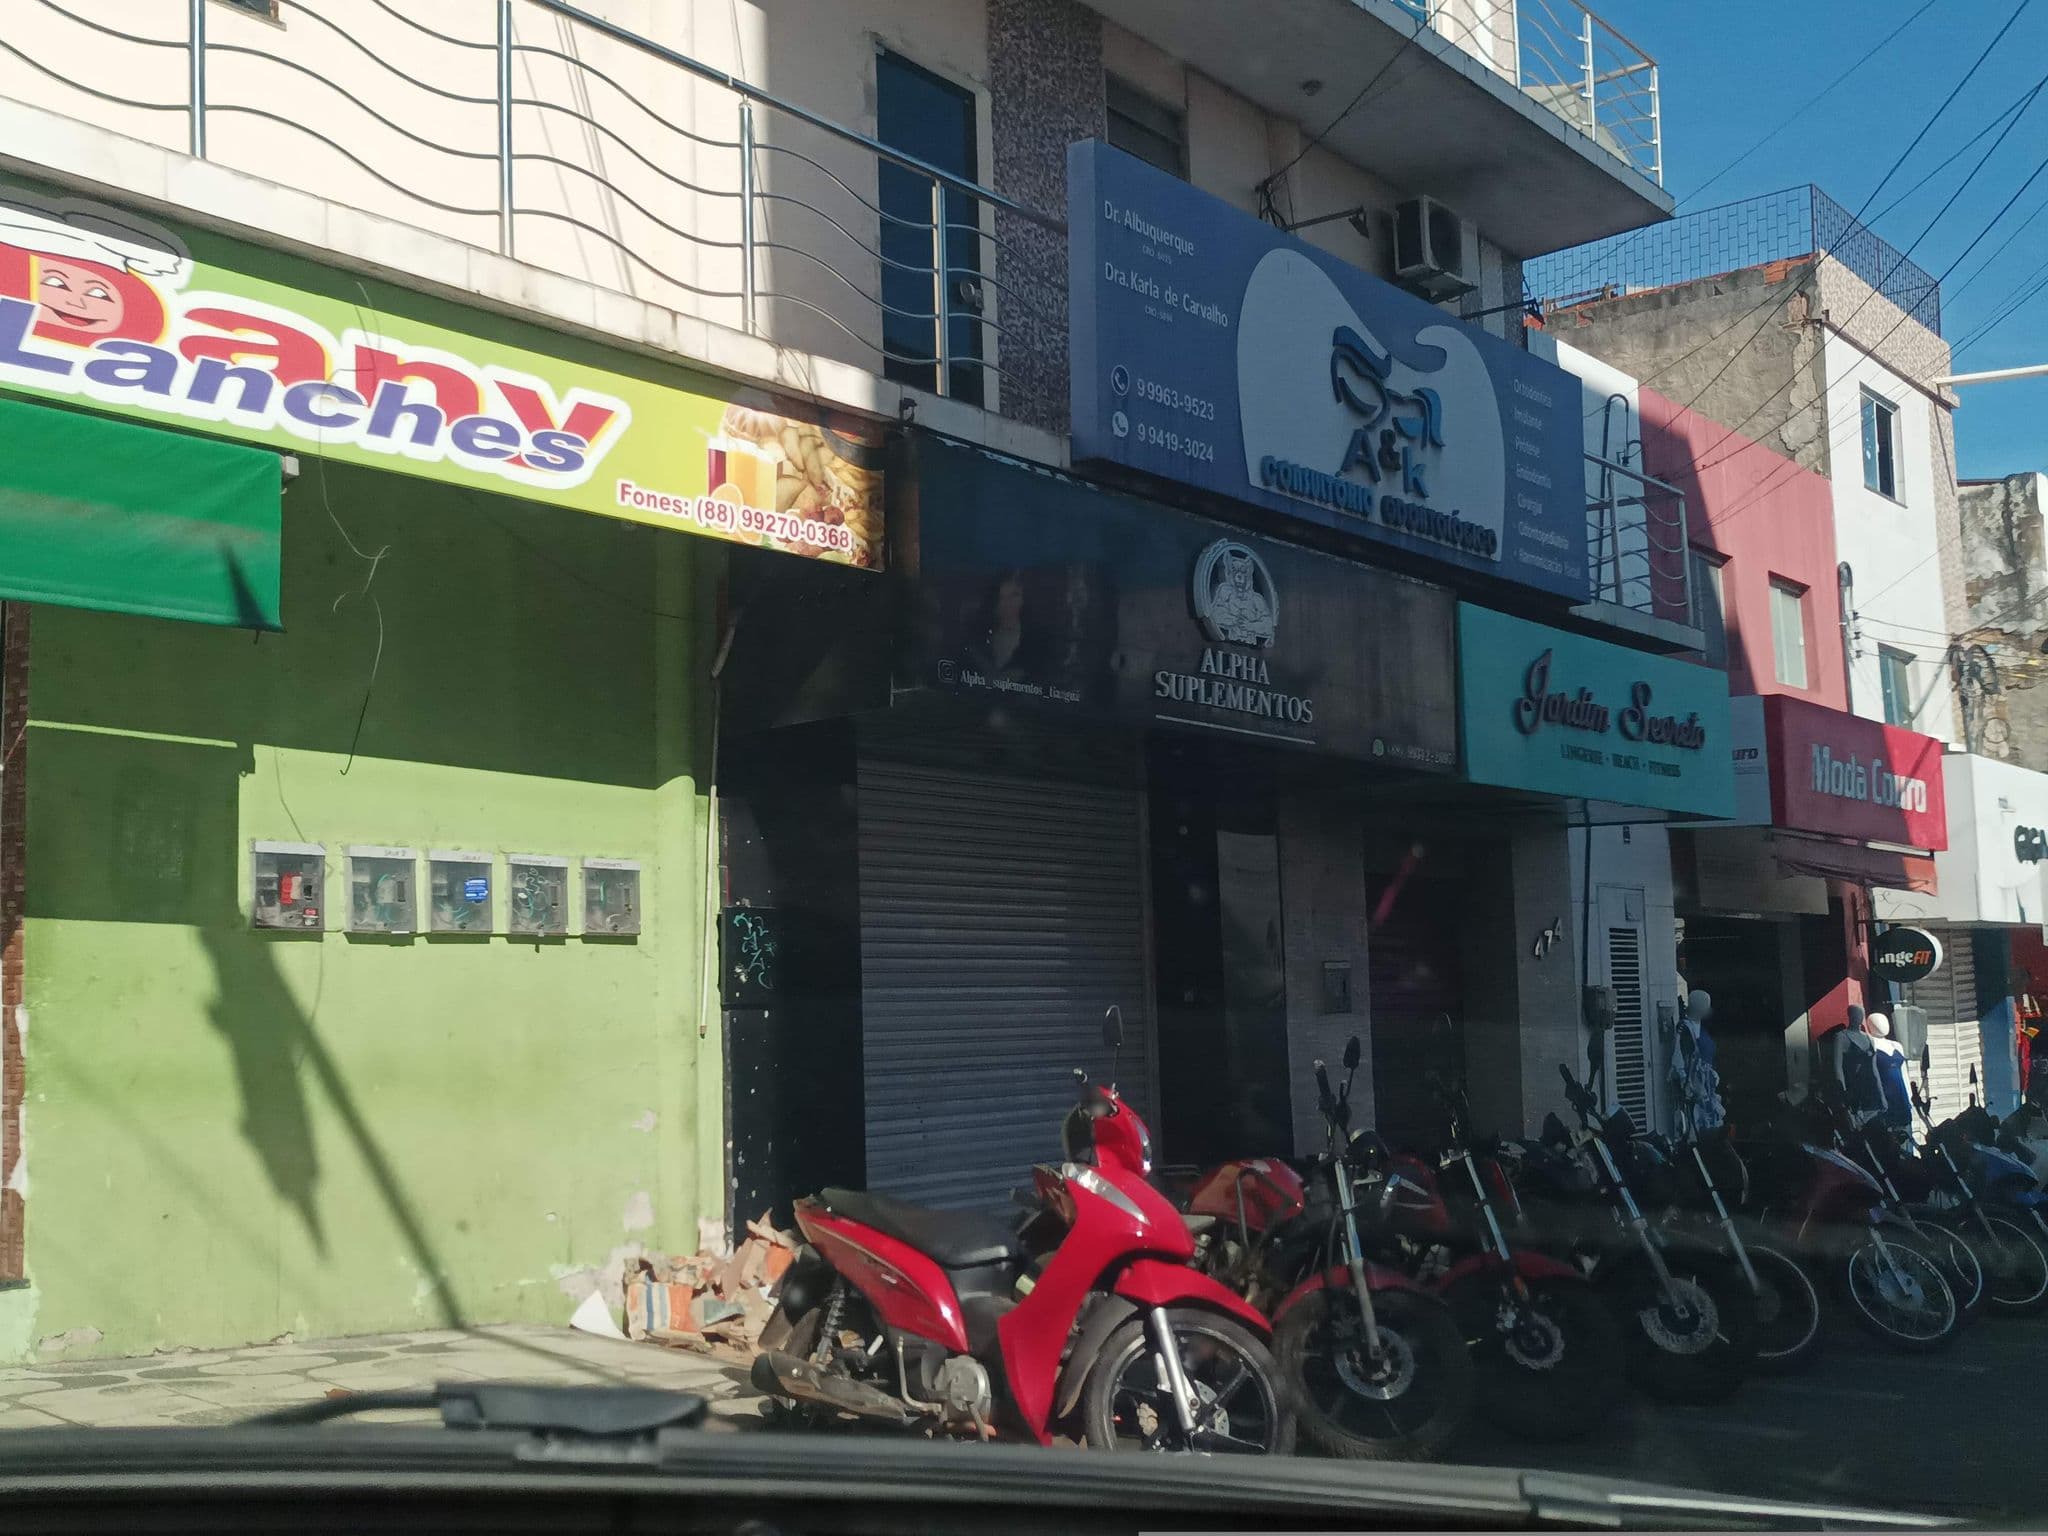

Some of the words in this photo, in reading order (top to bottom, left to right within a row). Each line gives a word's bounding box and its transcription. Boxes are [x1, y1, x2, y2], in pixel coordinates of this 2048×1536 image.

[1104, 200, 1121, 224] Dr.
[1124, 209, 1195, 256] Albuquerque
[1130, 271, 1160, 300] Karla
[1164, 286, 1179, 308] de
[1182, 293, 1229, 328] Carvalho
[0, 300, 585, 474] Lanches
[1148, 426, 1214, 463] 9419-3024
[620, 483, 690, 515] Fones:
[697, 498, 736, 530] (88)
[742, 508, 850, 549] 99270-0368
[1201, 647, 1271, 686] ALPHA
[1155, 671, 1314, 724] SUPLEMENTOS
[1811, 743, 1868, 800] Moda
